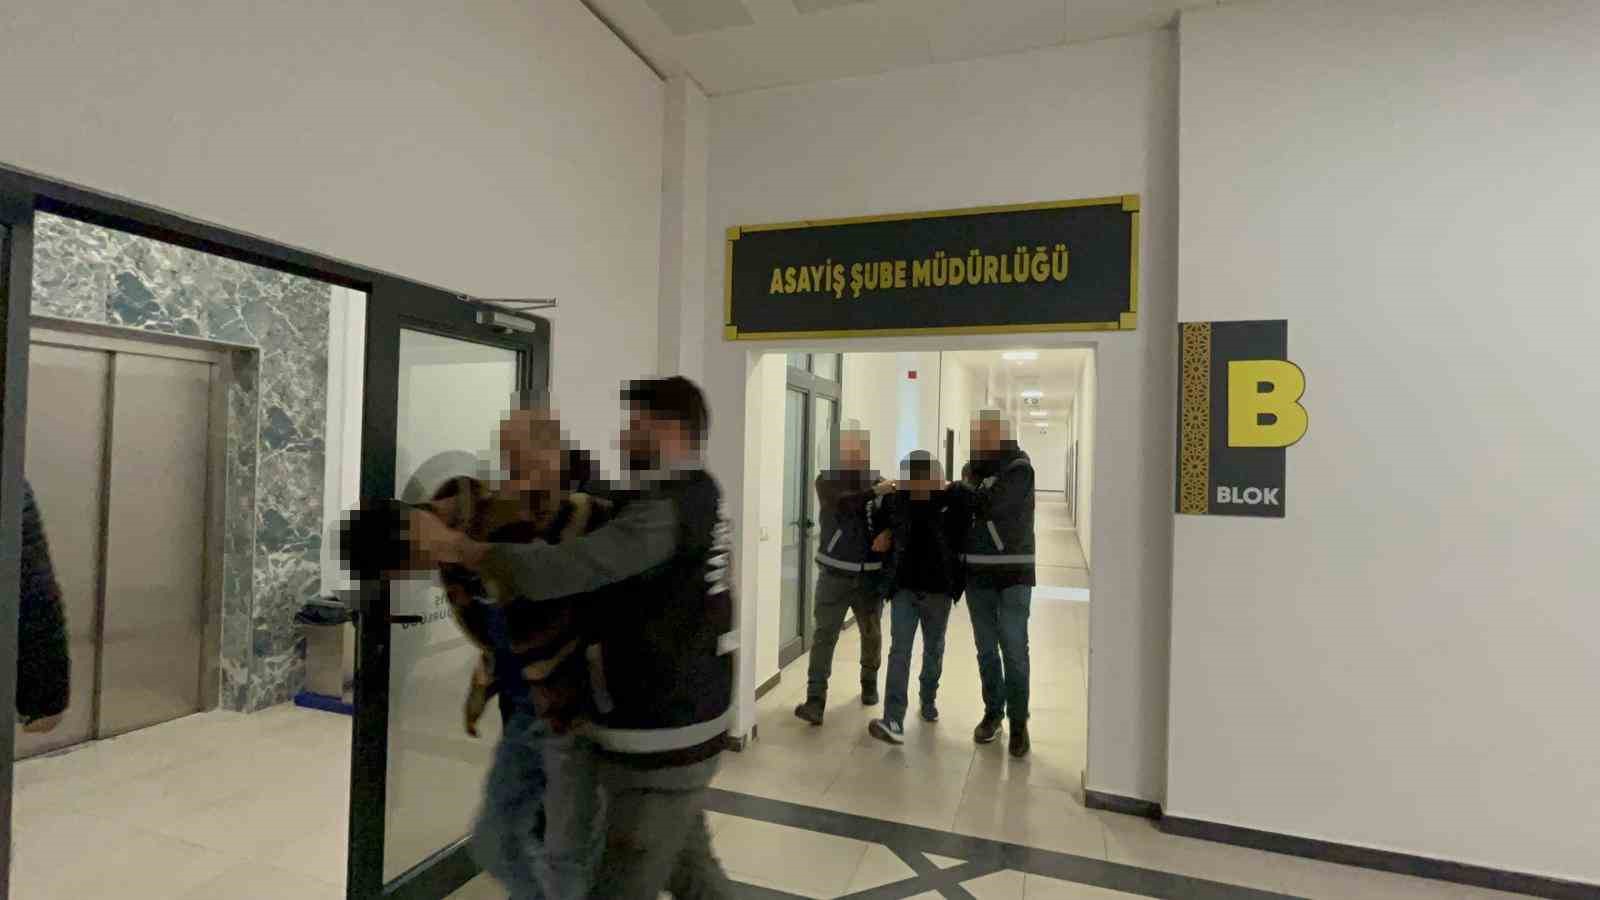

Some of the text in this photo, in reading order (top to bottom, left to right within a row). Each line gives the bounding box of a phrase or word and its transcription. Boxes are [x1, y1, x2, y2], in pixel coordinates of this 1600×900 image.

[769, 243, 1069, 299] ASAYİŞ ŞUBE MÜDÜRLÜĞÜ
[1227, 360, 1309, 448] B
[1216, 486, 1280, 505] BLOK
